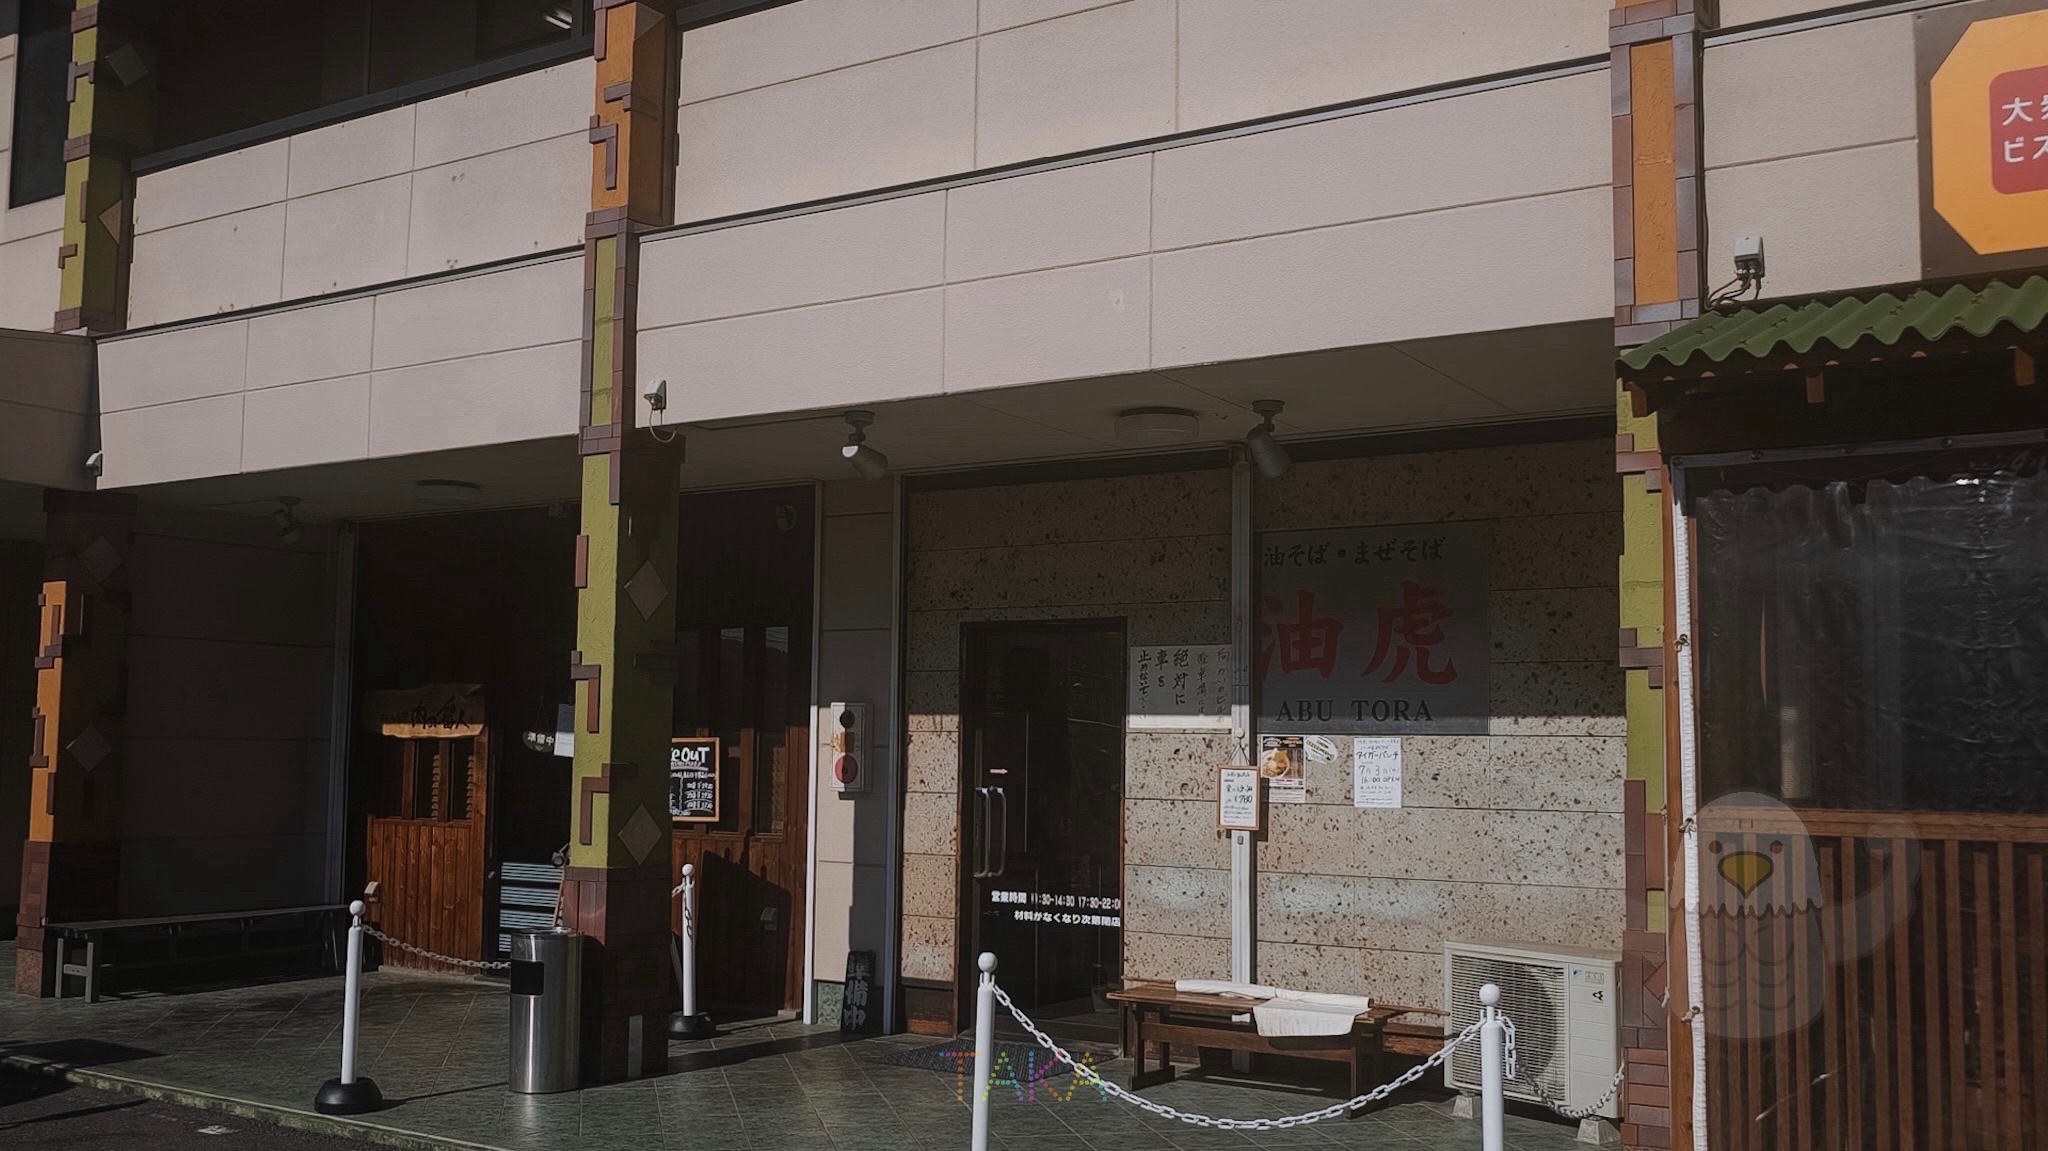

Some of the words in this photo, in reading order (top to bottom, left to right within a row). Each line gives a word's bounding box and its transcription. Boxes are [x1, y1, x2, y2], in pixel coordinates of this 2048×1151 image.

[1264, 536, 1447, 567] 油そば・まぜそば
[1262, 580, 1458, 685] 油虎
[1155, 649, 1169, 688] 車を
[1172, 648, 1189, 705] 絶対に
[1276, 700, 1333, 721] ABU
[1351, 700, 1433, 721] TORA
[991, 890, 1027, 904] 営業時間
